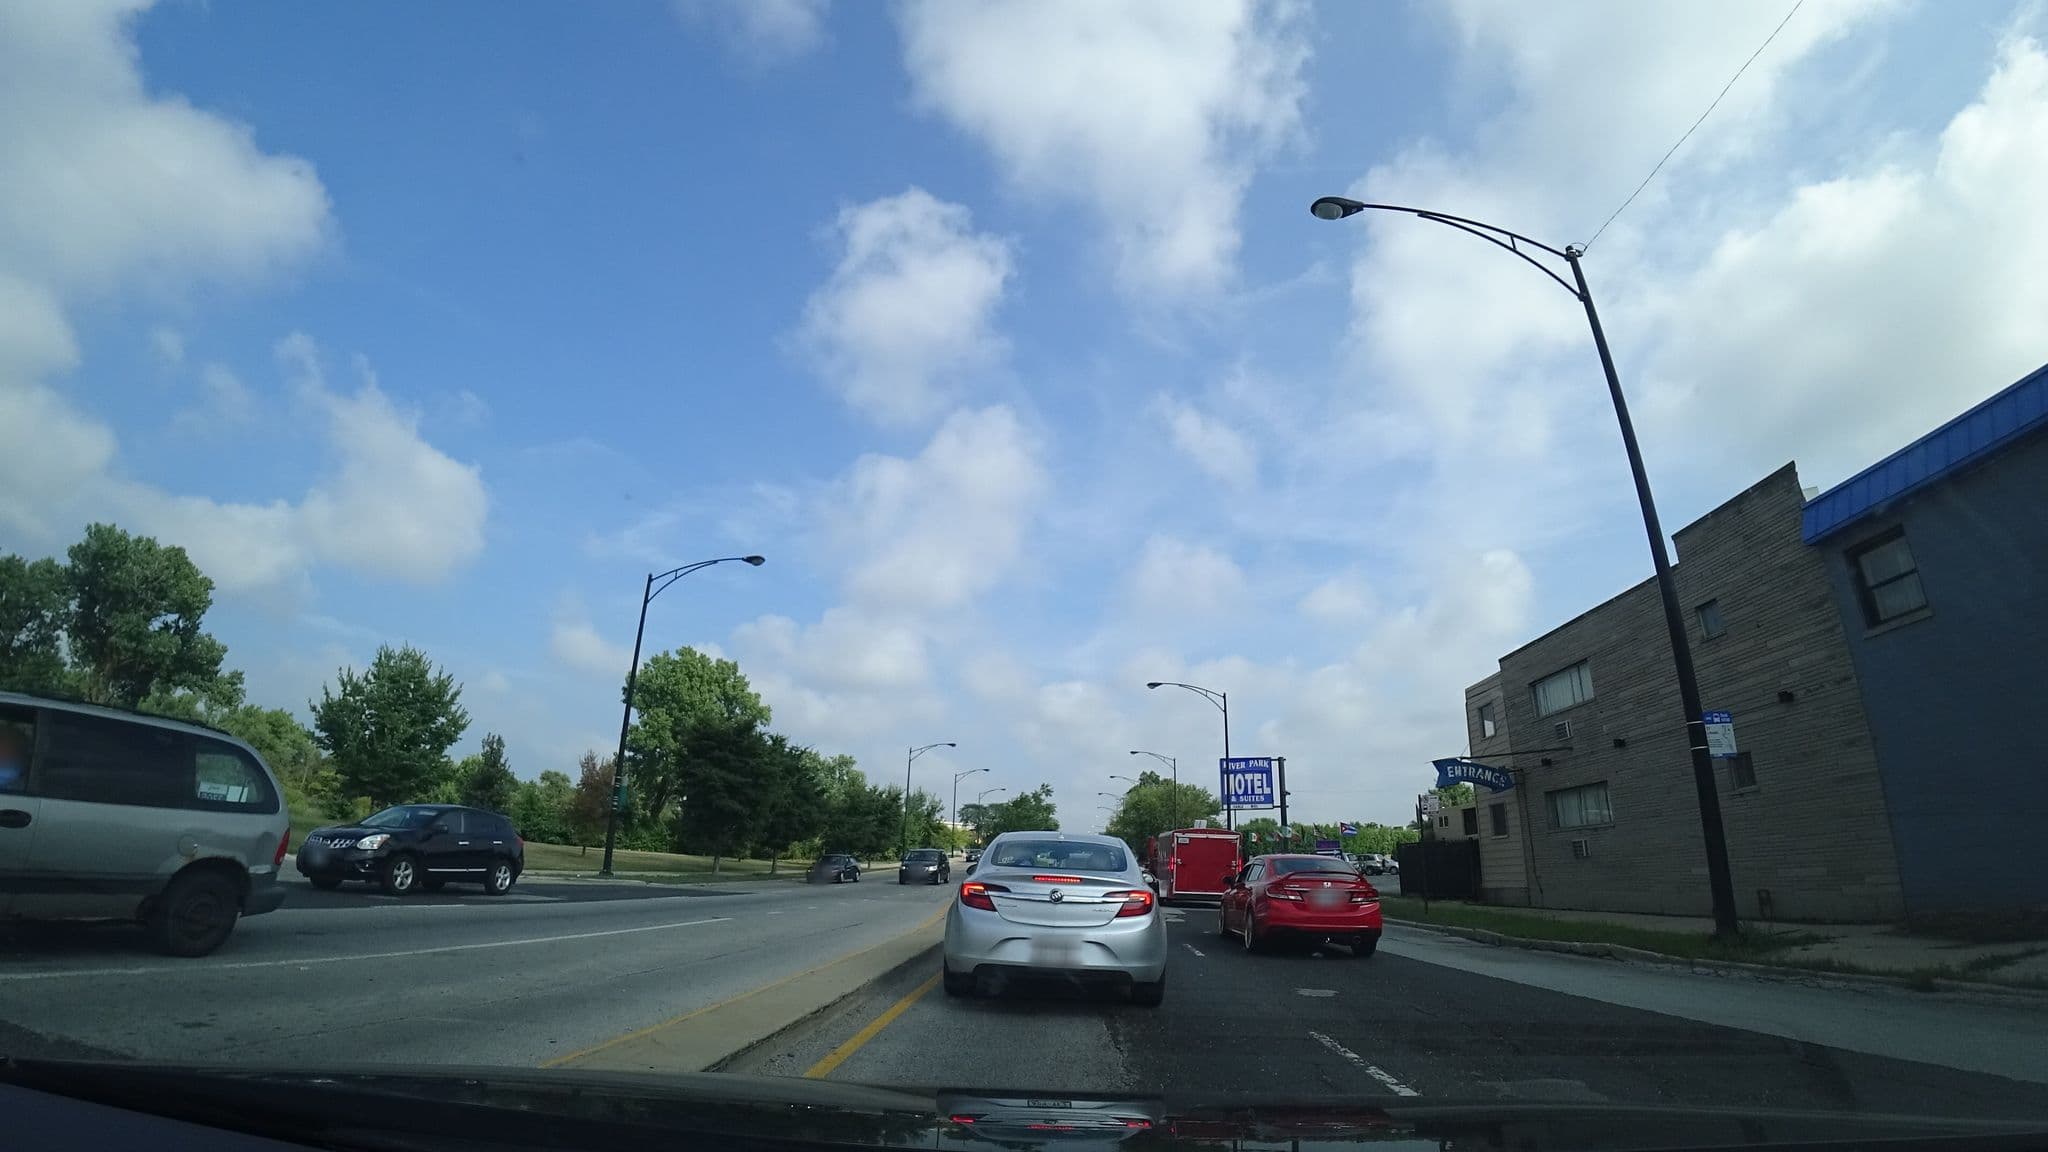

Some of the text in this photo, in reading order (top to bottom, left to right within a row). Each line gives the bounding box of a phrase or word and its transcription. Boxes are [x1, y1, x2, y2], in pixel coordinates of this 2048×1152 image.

[1249, 759, 1269, 768] PARK
[1224, 773, 1271, 795] MOTEL
[1447, 765, 1507, 787] ENTRANCE
